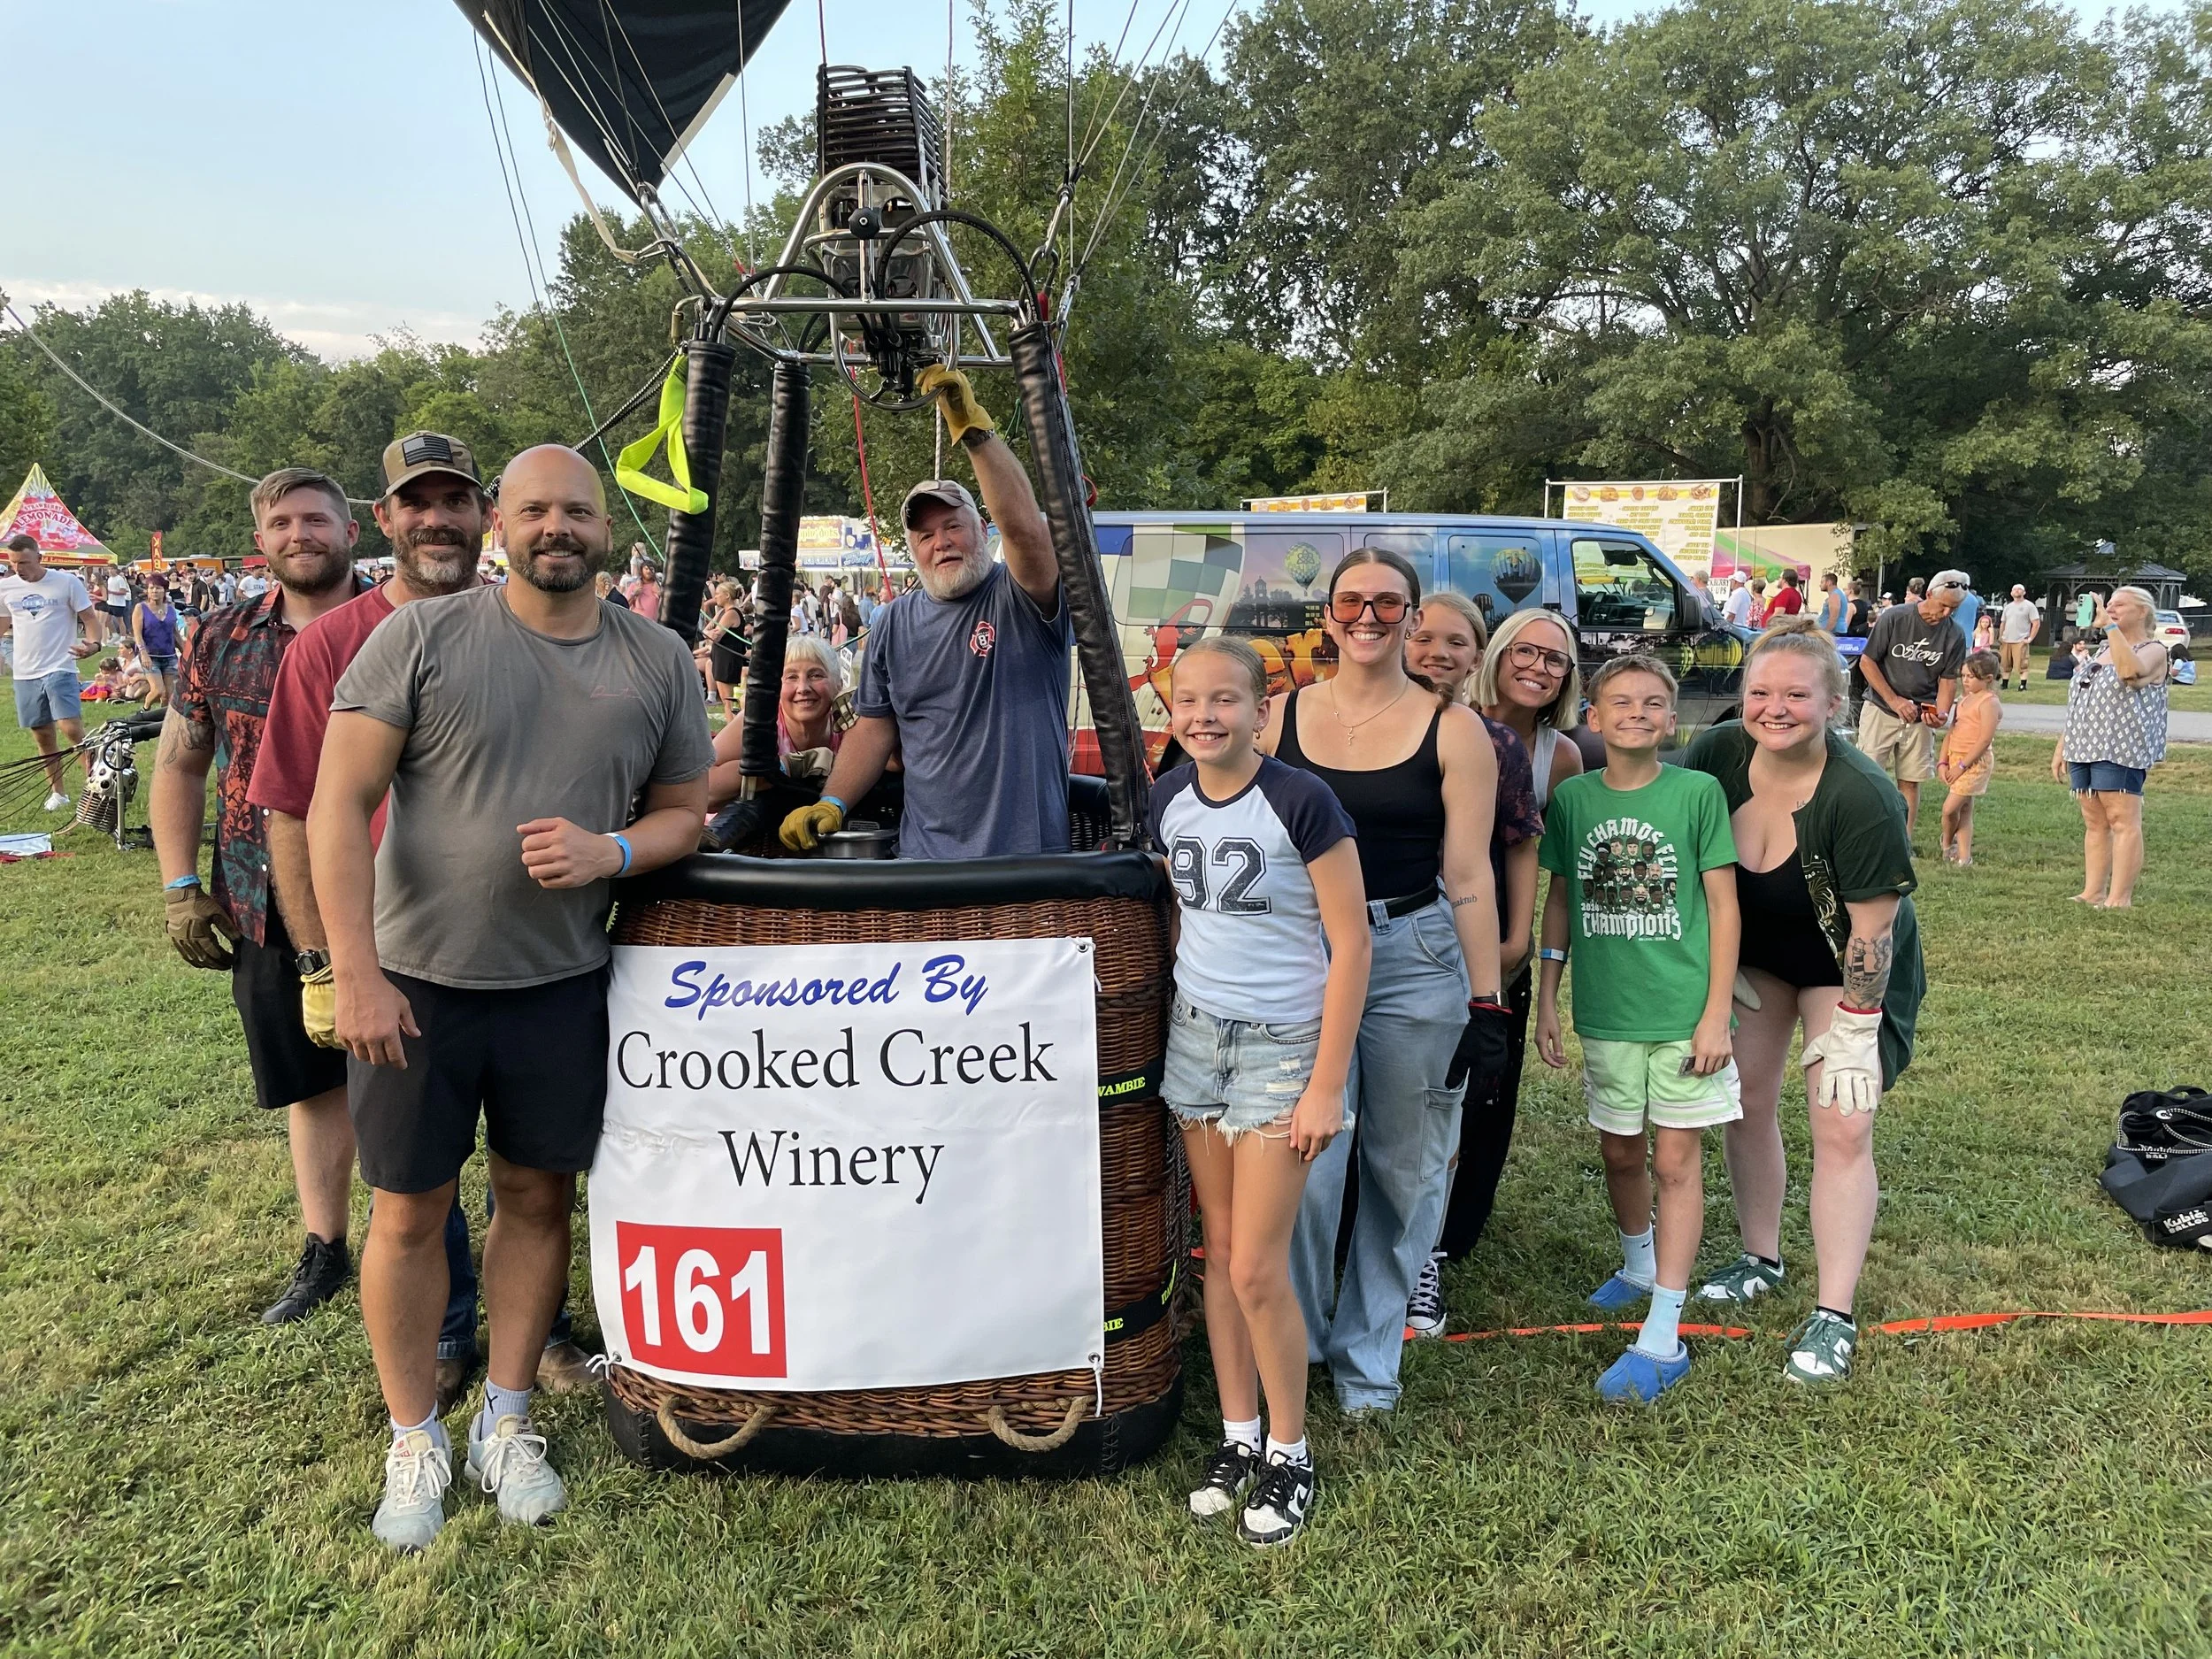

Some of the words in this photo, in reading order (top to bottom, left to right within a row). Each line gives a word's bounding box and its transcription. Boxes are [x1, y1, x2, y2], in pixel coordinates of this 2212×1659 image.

[16, 510, 75, 528] LEMONADE
[1171, 836, 1271, 915] 92
[1582, 912, 1681, 941] CHAMPIONS
[664, 960, 901, 1019] Sponsored
[922, 954, 988, 1015] By
[618, 1027, 859, 1089] Crooked
[880, 1022, 1057, 1085] Creek
[718, 1131, 944, 1204] Winery
[625, 1245, 771, 1354] 161
